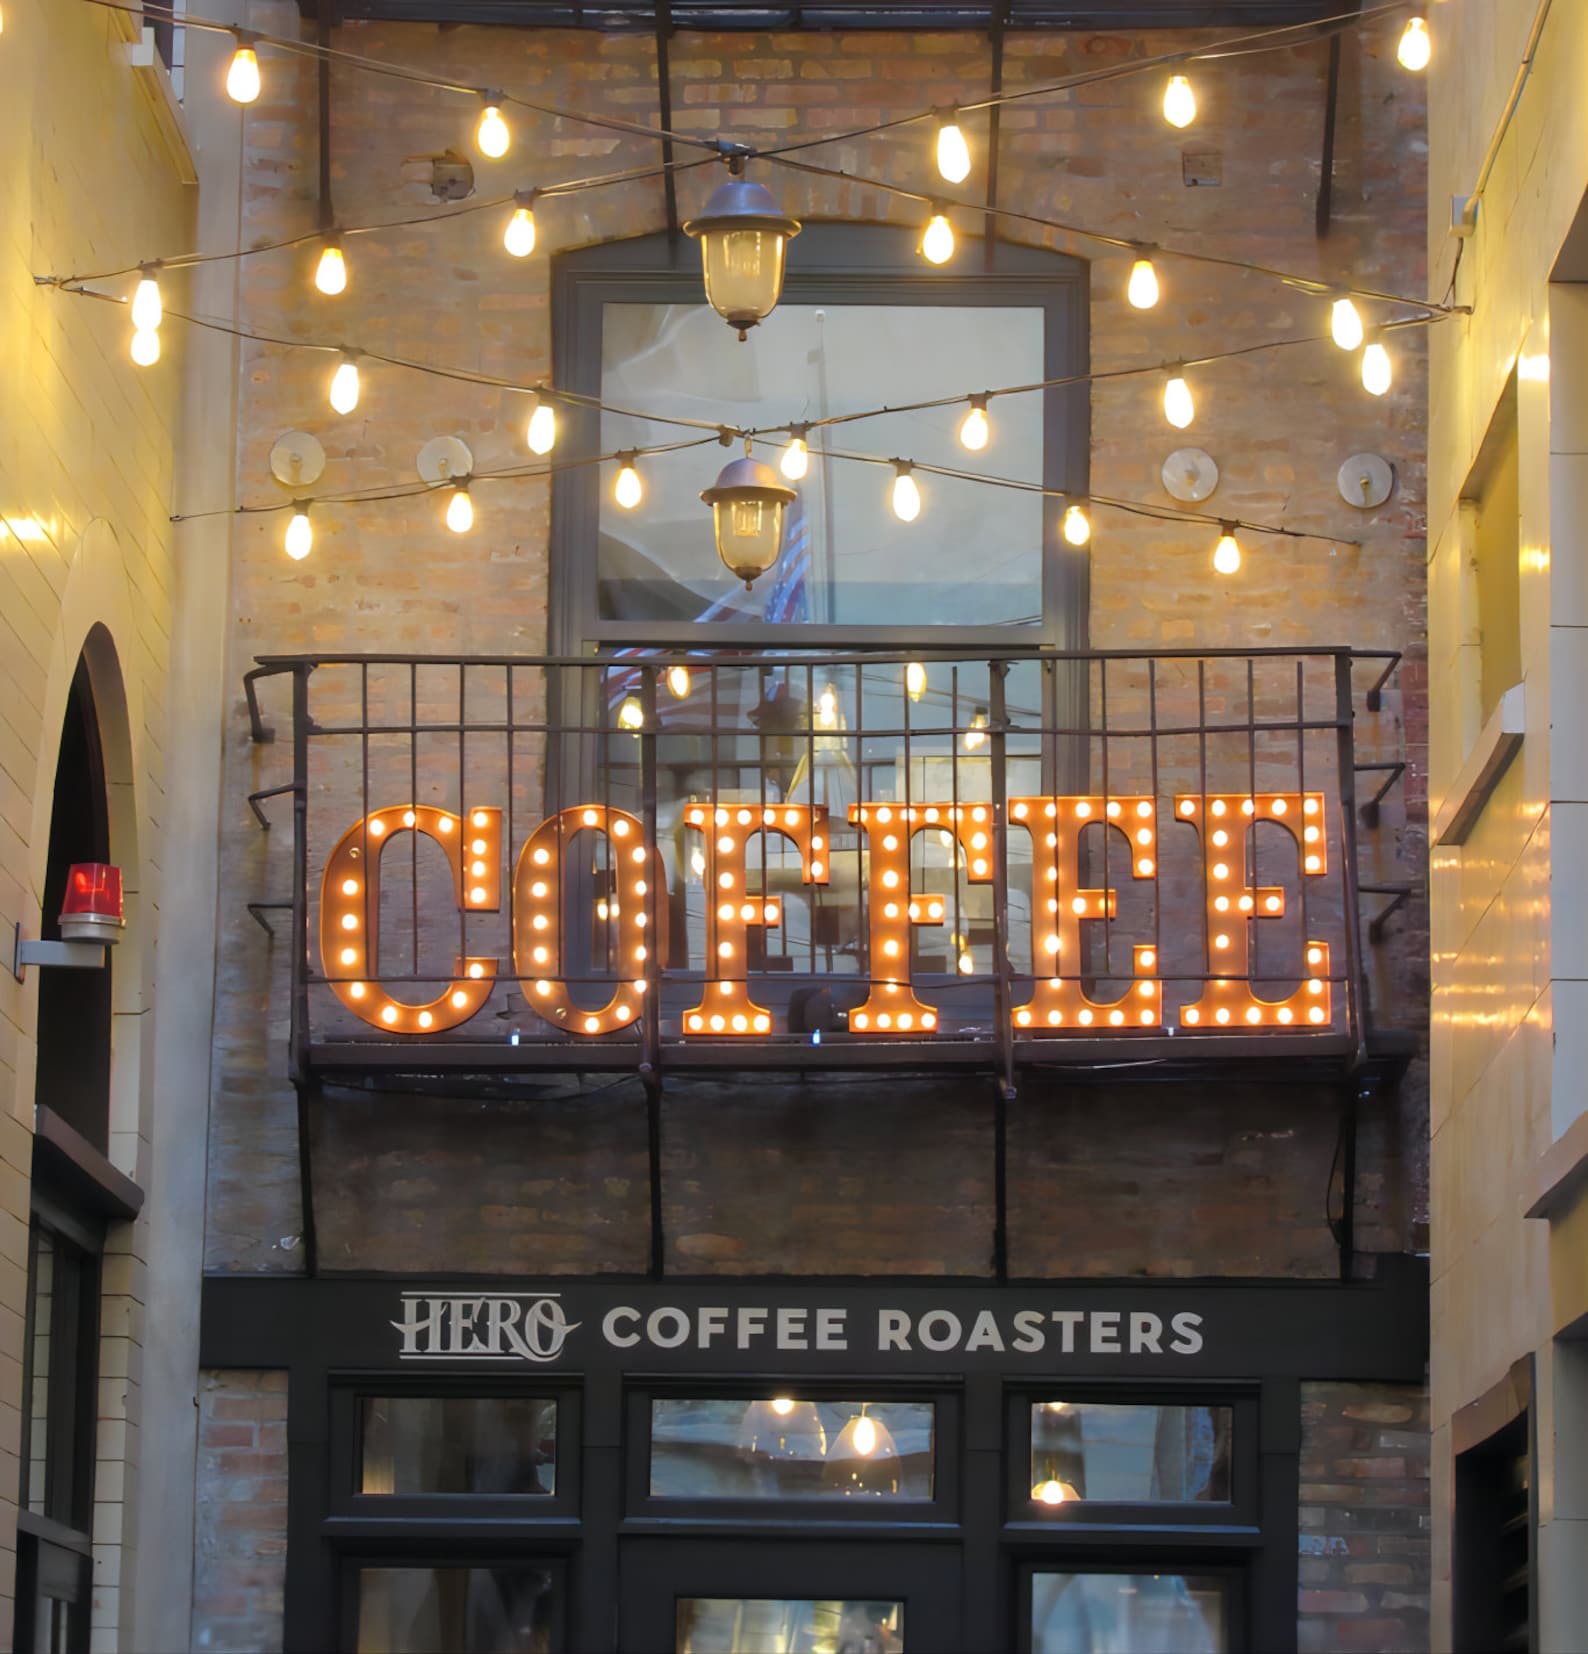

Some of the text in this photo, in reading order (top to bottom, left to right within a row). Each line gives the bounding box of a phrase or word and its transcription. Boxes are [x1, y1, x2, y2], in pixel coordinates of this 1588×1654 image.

[320, 792, 1330, 1035] COFFEE
[391, 1291, 1204, 1362] HERO COFFEE ROASTERS
